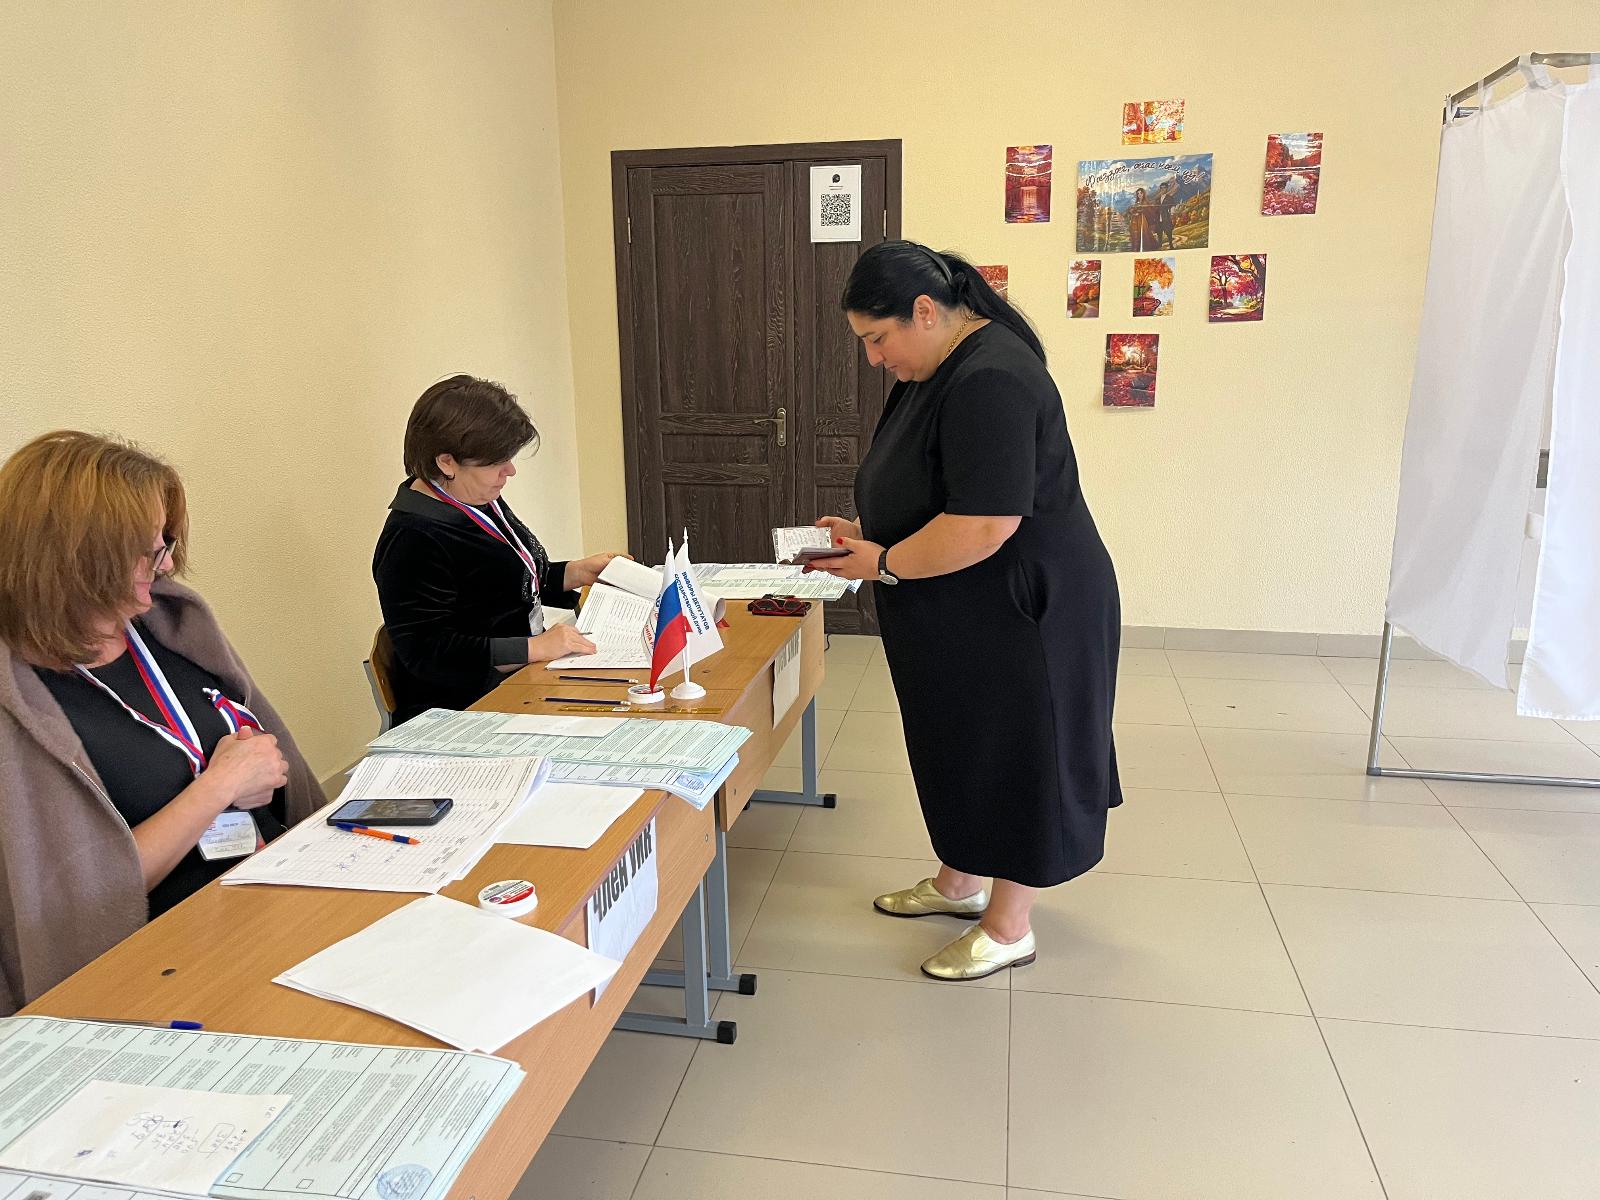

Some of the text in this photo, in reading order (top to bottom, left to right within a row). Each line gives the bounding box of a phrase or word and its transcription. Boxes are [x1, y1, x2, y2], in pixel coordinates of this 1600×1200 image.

[681, 571, 710, 631] ВЫБОРЫ ДЕПУТАТОВ
[628, 822, 652, 879] УИК
